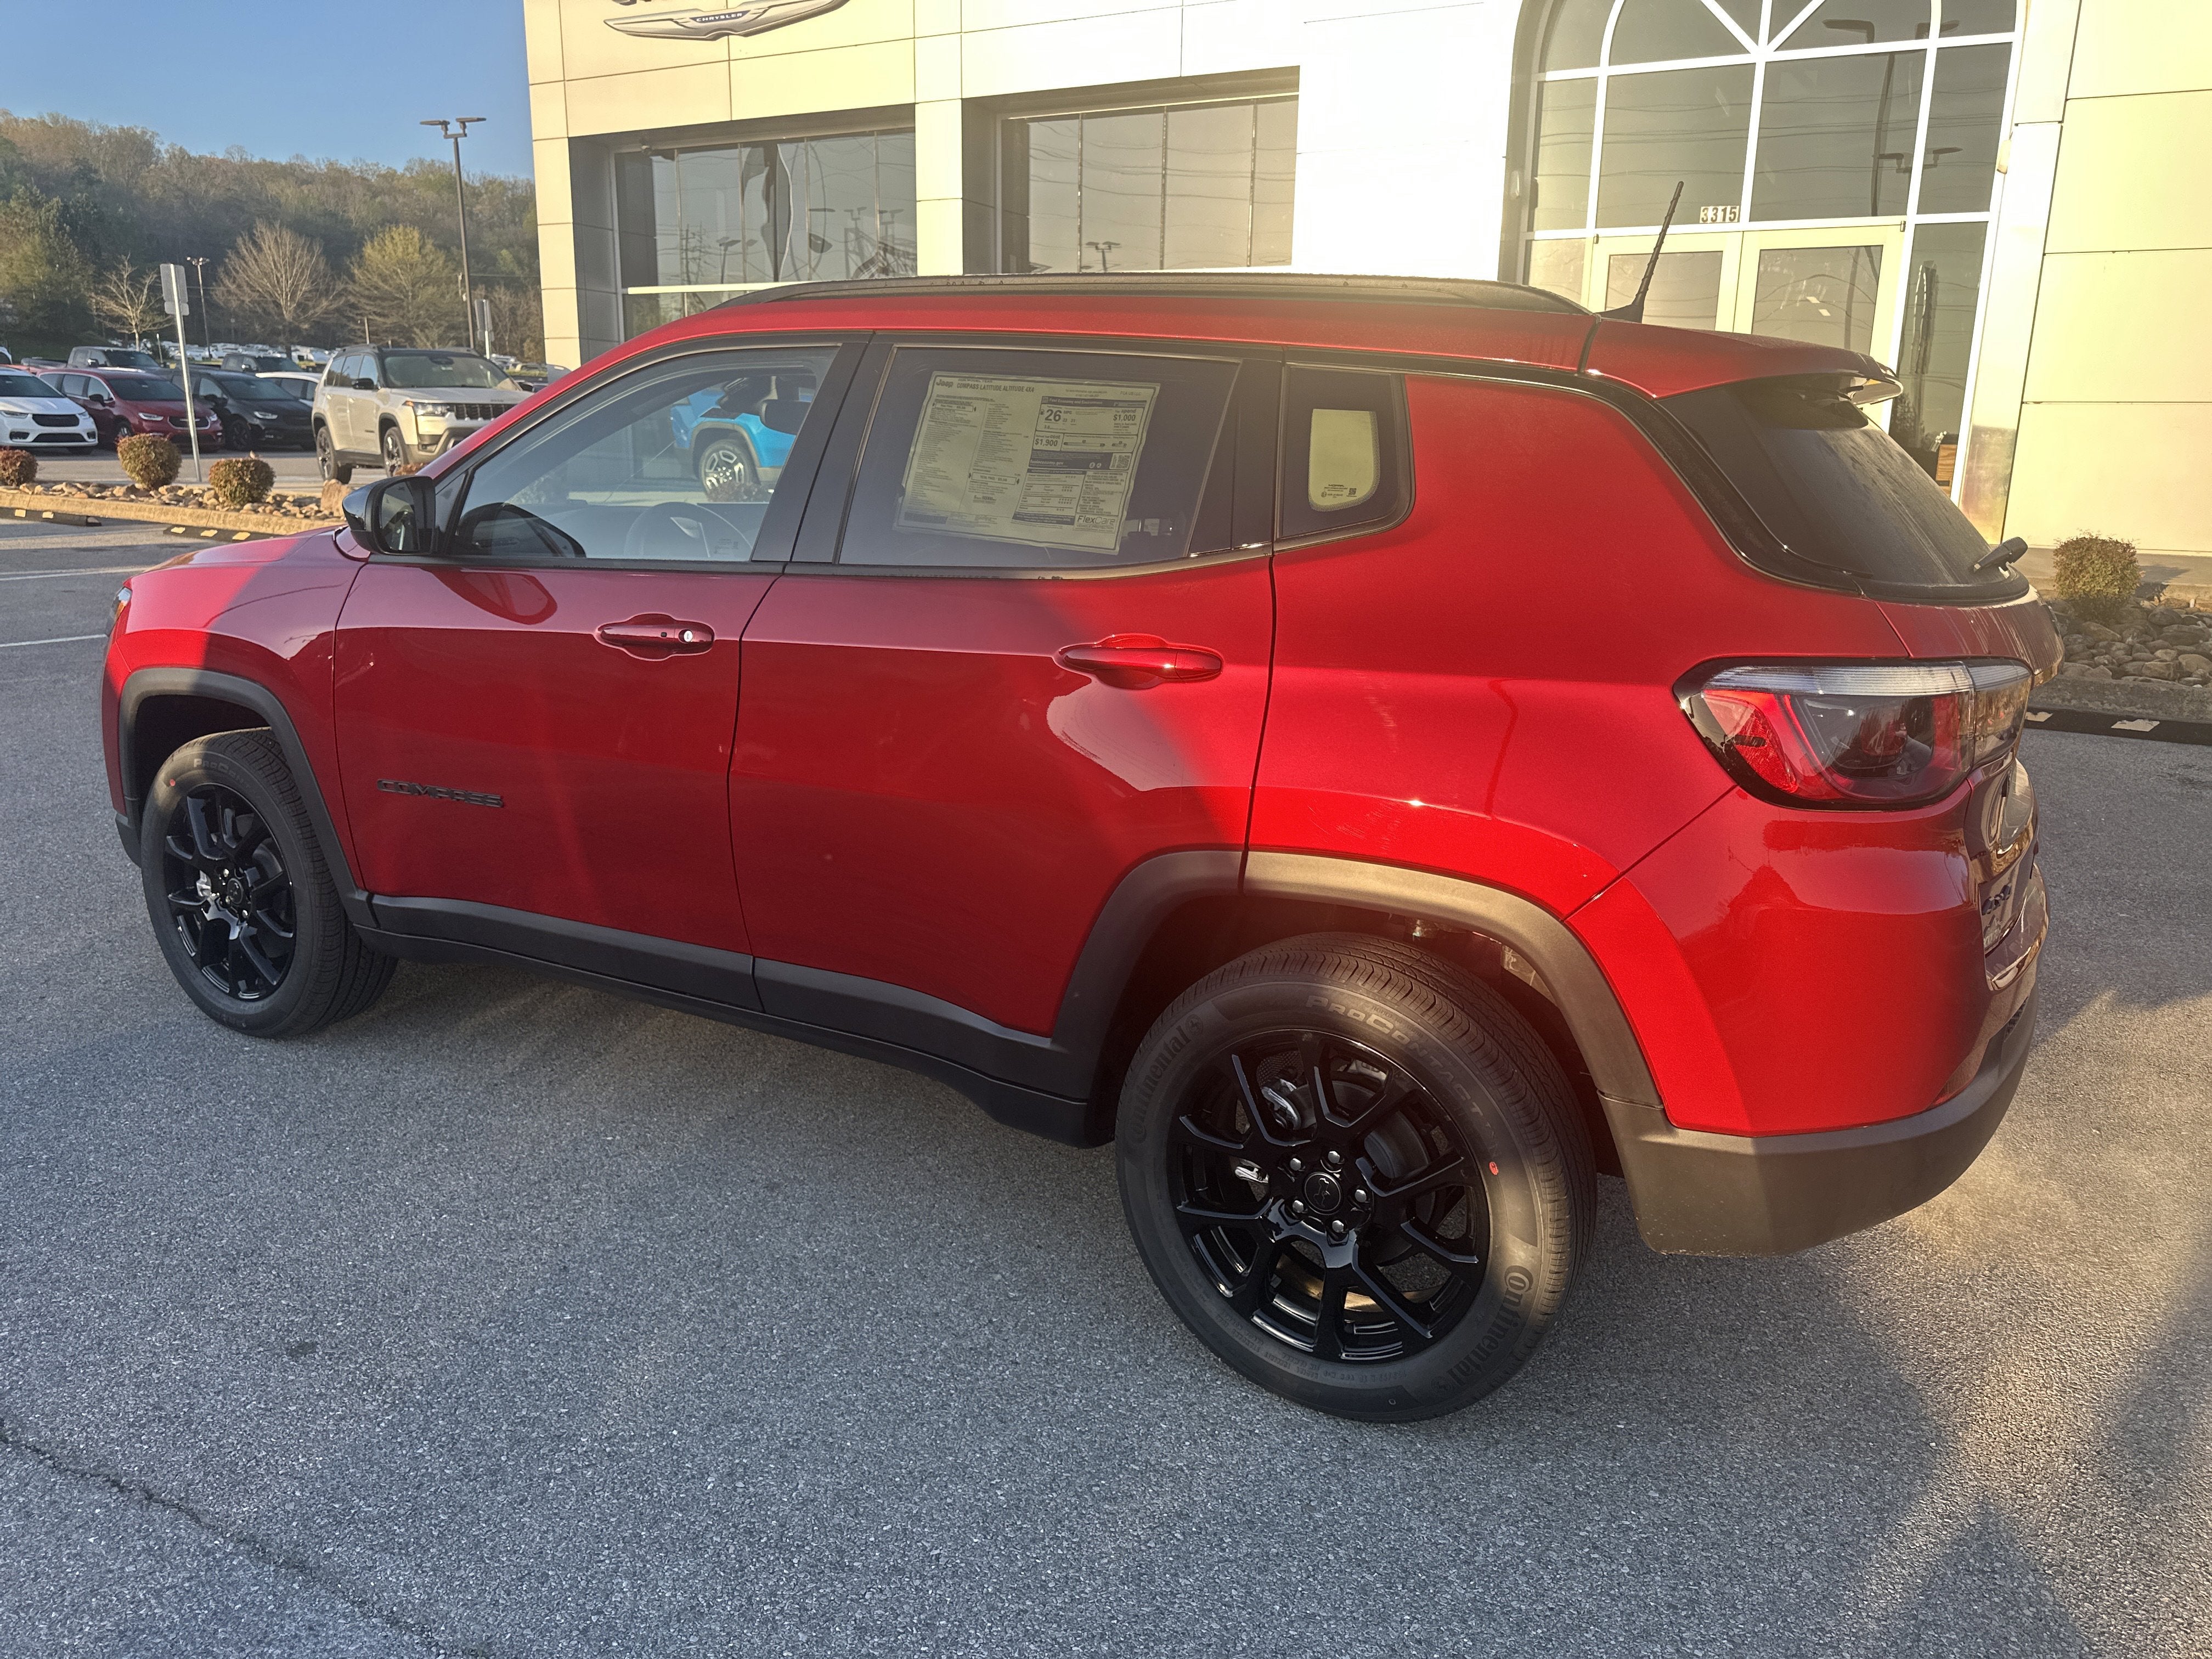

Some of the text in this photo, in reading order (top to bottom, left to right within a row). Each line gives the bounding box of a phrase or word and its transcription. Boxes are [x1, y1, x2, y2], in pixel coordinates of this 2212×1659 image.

[696, 13, 742, 22] CHRYSLER
[1701, 206, 1737, 223] 3315
[936, 379, 953, 388] Jeep
[1045, 409, 1062, 422] 26
[1113, 414, 1136, 422] $1,000
[1035, 438, 1058, 447] $1,900
[1077, 515, 1115, 525] FlexCare
[377, 778, 504, 808] COMPASS
[1446, 1265, 1534, 1387] Continental
